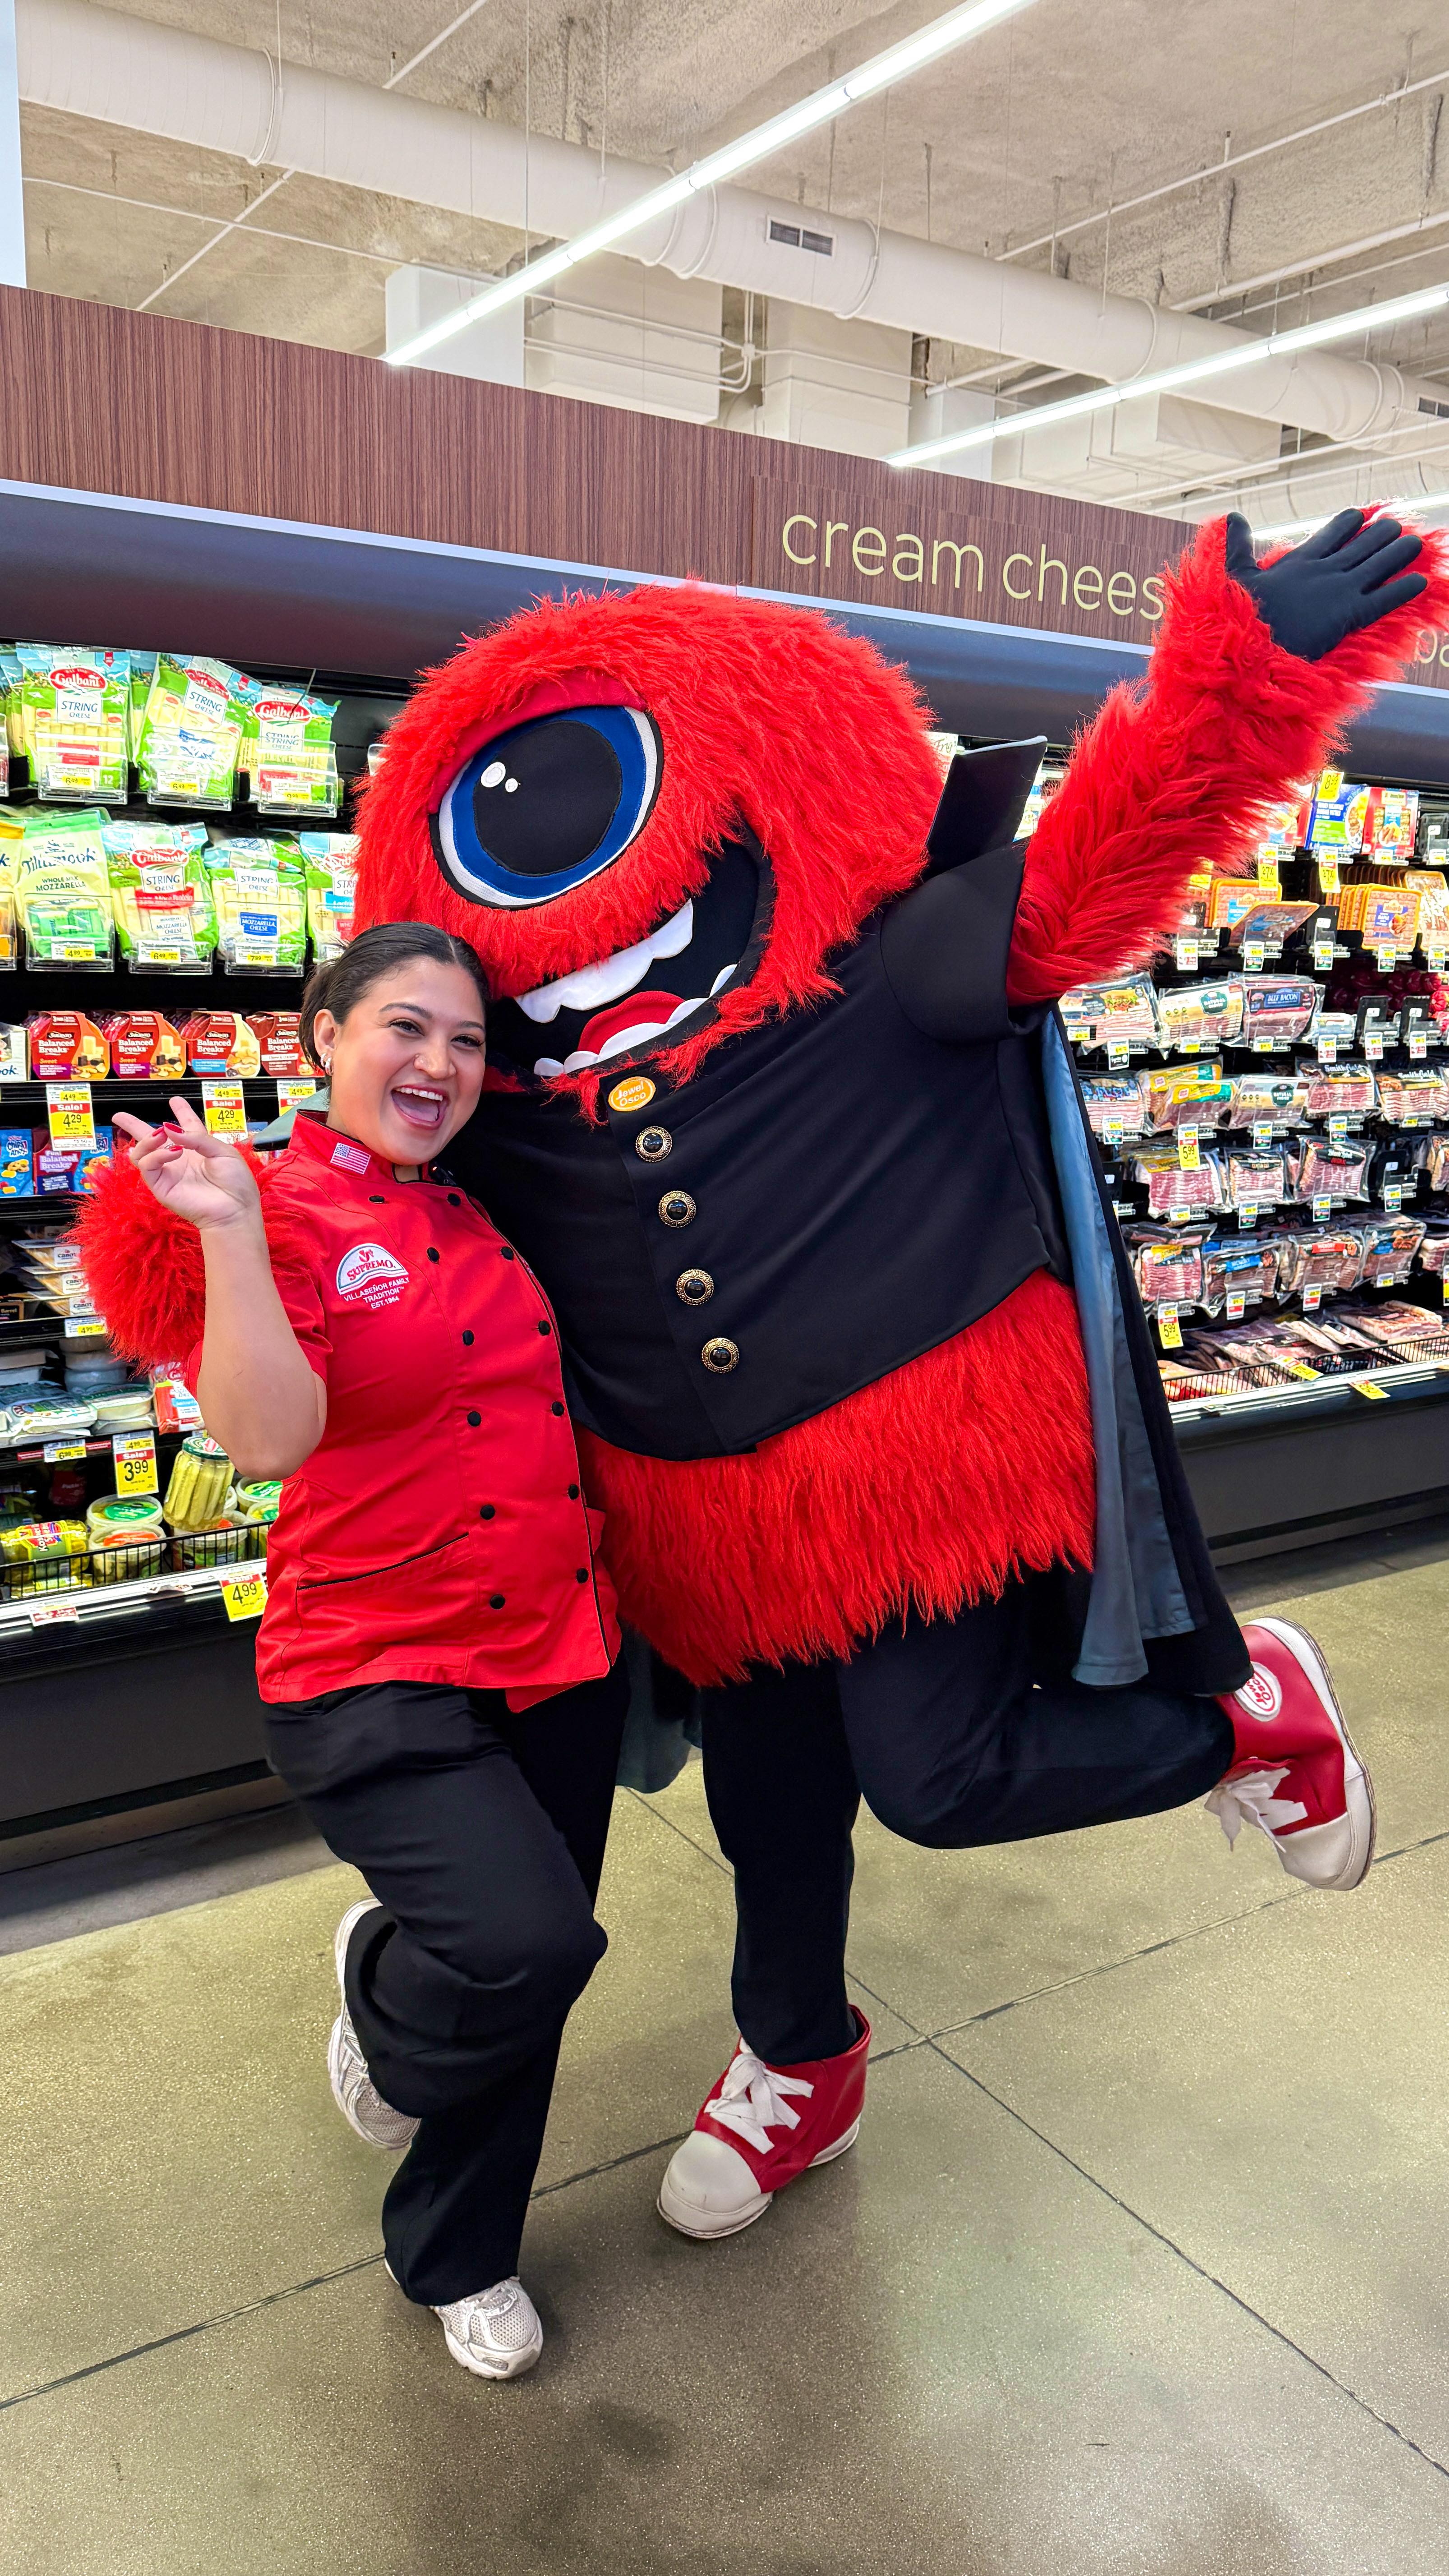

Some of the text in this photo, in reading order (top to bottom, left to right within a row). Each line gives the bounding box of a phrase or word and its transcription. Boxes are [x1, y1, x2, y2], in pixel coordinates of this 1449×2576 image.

[782, 514, 1165, 620] cream chees
[55, 672, 100, 688] Galbani
[61, 701, 98, 712] STRING
[189, 692, 222, 712] STRING
[102, 775, 114, 785] 12
[36, 881, 86, 892] MOZZARELLA
[146, 875, 180, 886] STRING
[242, 919, 275, 927] MOZZARELLA
[267, 1036, 300, 1044] Balanced
[616, 1080, 644, 1100] Jewel
[619, 1092, 646, 1107] Osco
[40, 1154, 78, 1163] Balanced
[347, 1260, 393, 1281] SUPREMO
[343, 1277, 410, 1302] VILLASEÑOR FAMILY
[122, 1451, 147, 1460] Sale!
[1246, 1680, 1268, 1705] Jewe
[1252, 1675, 1271, 1700] Osc
